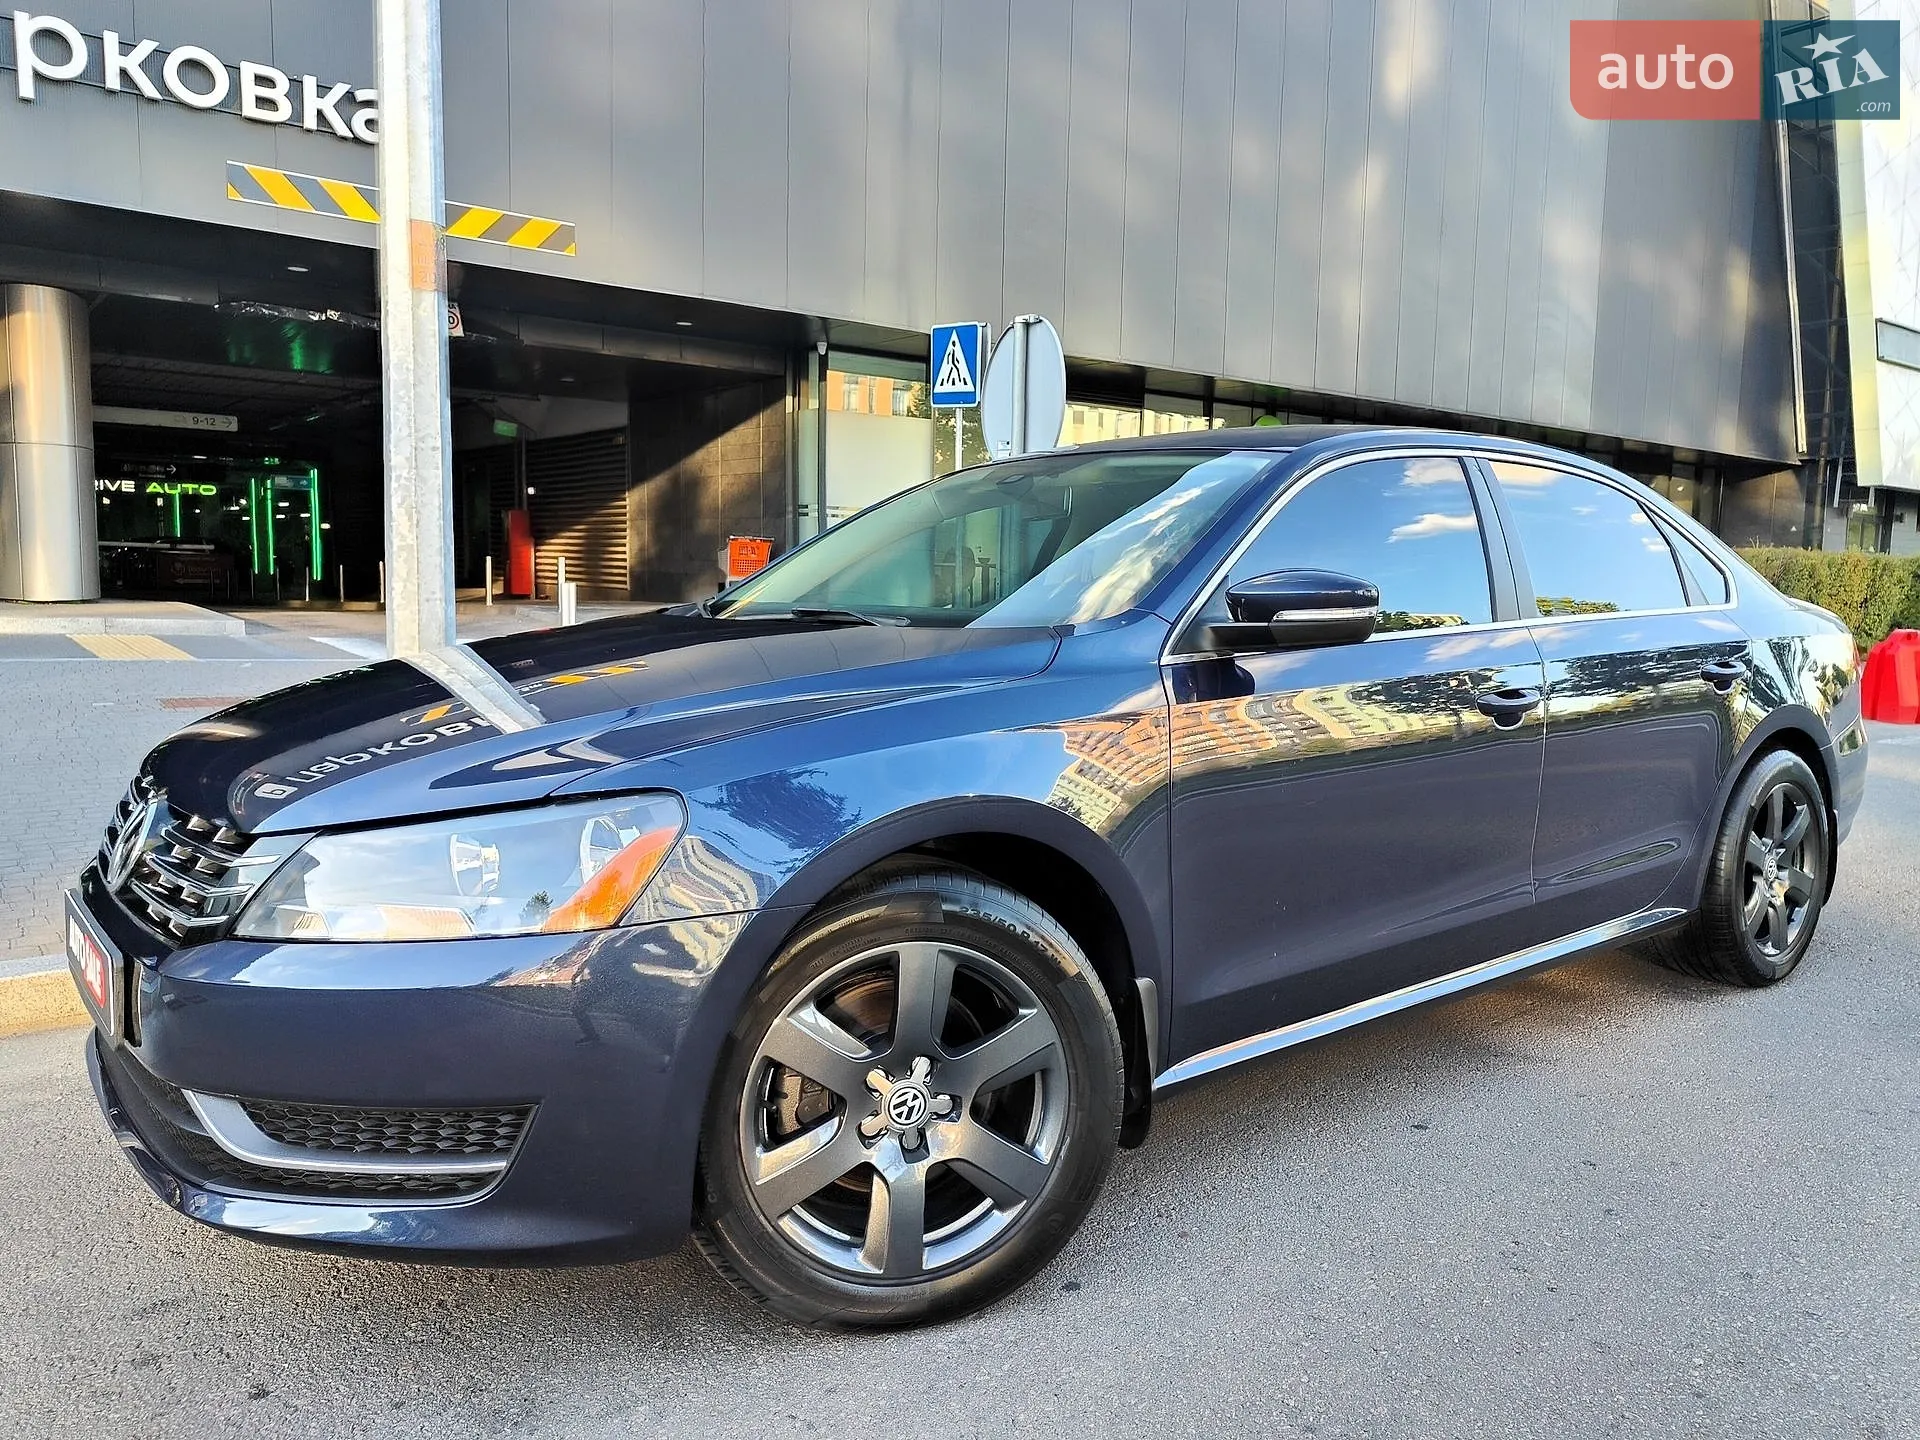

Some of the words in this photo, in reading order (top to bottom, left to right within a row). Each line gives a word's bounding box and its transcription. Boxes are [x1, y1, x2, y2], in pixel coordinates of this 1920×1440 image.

[192, 416, 216, 427] 9-12
[95, 479, 135, 493] IVE
[145, 482, 217, 496] AUTO
